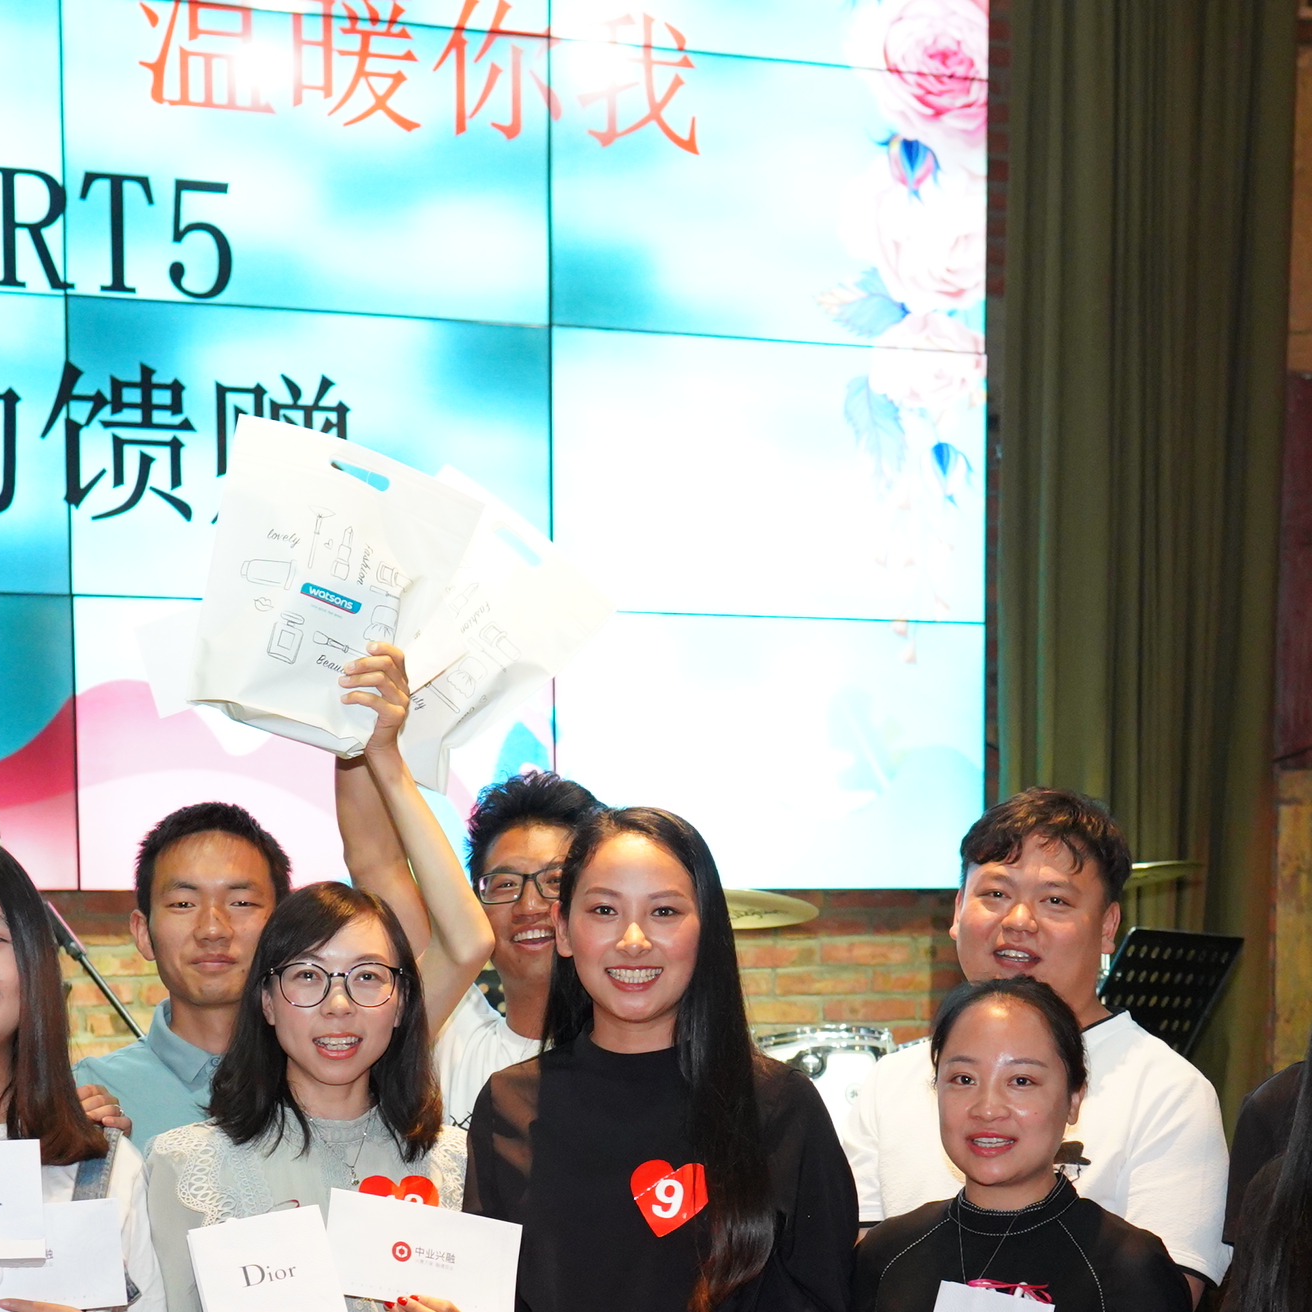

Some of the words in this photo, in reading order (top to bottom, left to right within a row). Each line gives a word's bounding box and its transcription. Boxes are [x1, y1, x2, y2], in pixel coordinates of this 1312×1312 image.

[139, 0, 700, 155] 温暖你我
[356, 543, 374, 585] Fashion
[309, 586, 354, 610] watsons
[316, 654, 348, 676] Beau
[651, 1179, 684, 1219] 9
[240, 1263, 297, 1289] Dior
